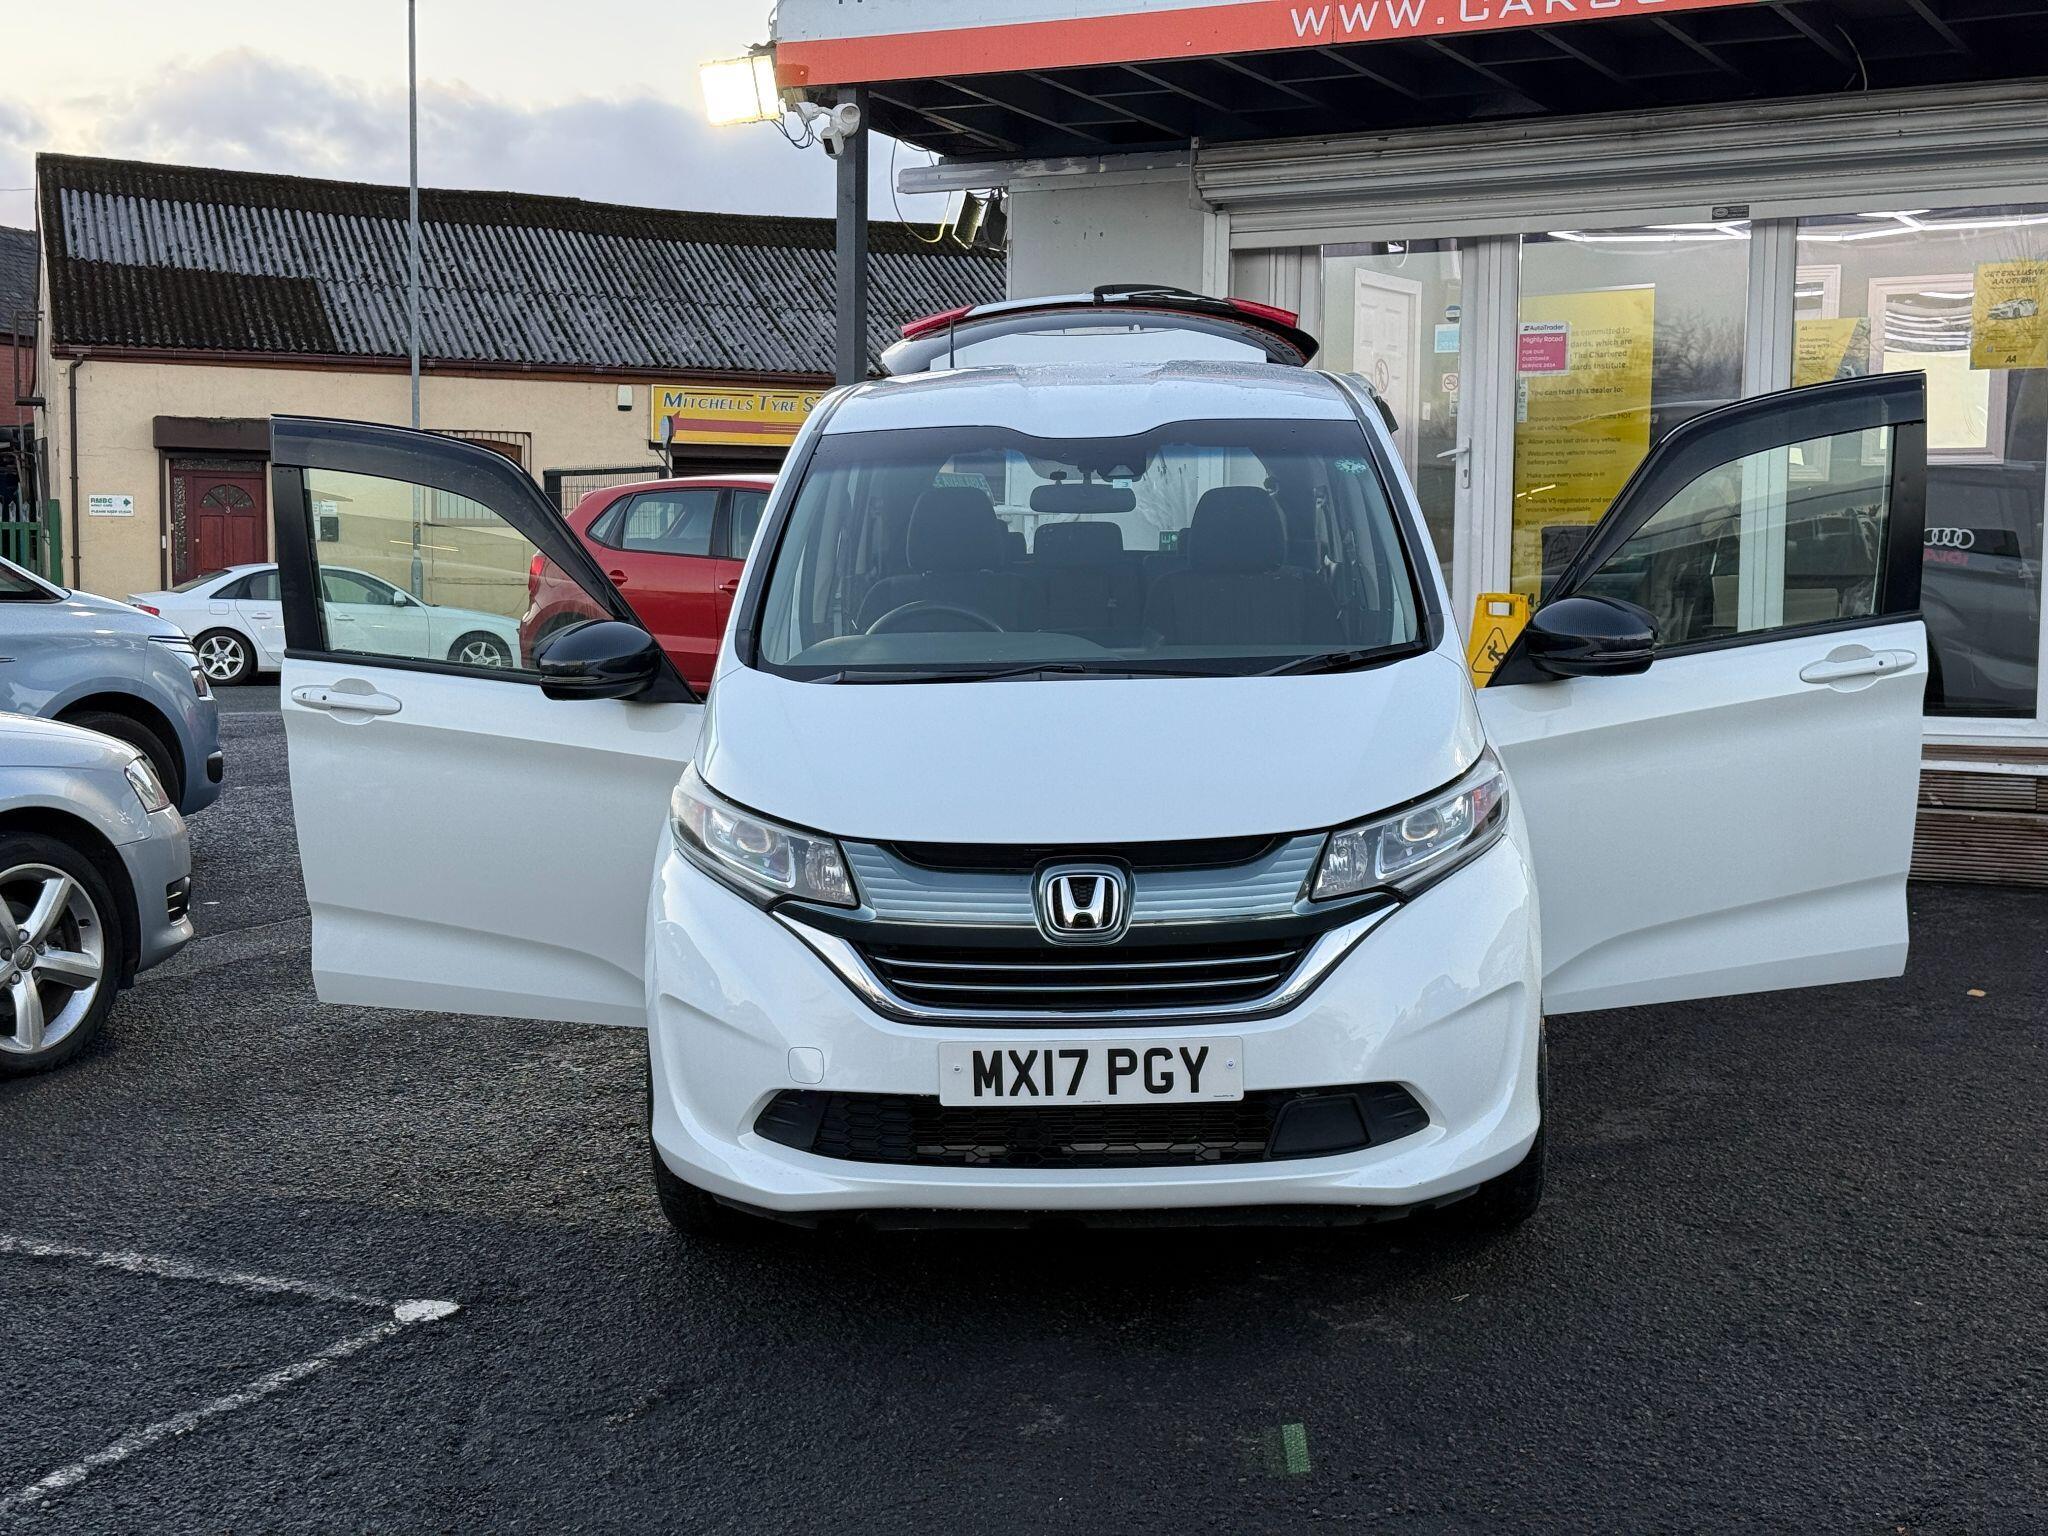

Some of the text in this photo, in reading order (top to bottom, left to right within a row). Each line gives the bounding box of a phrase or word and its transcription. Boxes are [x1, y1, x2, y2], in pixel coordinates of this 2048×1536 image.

[1582, 327, 1621, 338] committed
[1622, 327, 1630, 336] to
[1522, 335, 1543, 344] Highly
[1595, 339, 1620, 348] which
[1574, 350, 1628, 360] The Chartered
[2004, 355, 2017, 363] AA
[1593, 361, 1629, 370] Institute.
[1531, 389, 1543, 397] You
[1558, 388, 1575, 396] trust
[1576, 387, 1590, 395] this
[1590, 386, 1613, 394] dealer
[663, 391, 753, 411] MITCHELLS
[758, 394, 799, 412] TYRE
[1617, 412, 1632, 420] MOT
[1555, 450, 1565, 458] any
[1587, 449, 1617, 457] inspection
[1556, 472, 1573, 480] every
[1557, 496, 1589, 505] registration
[971, 1045, 1211, 1097] MX17 PGY
